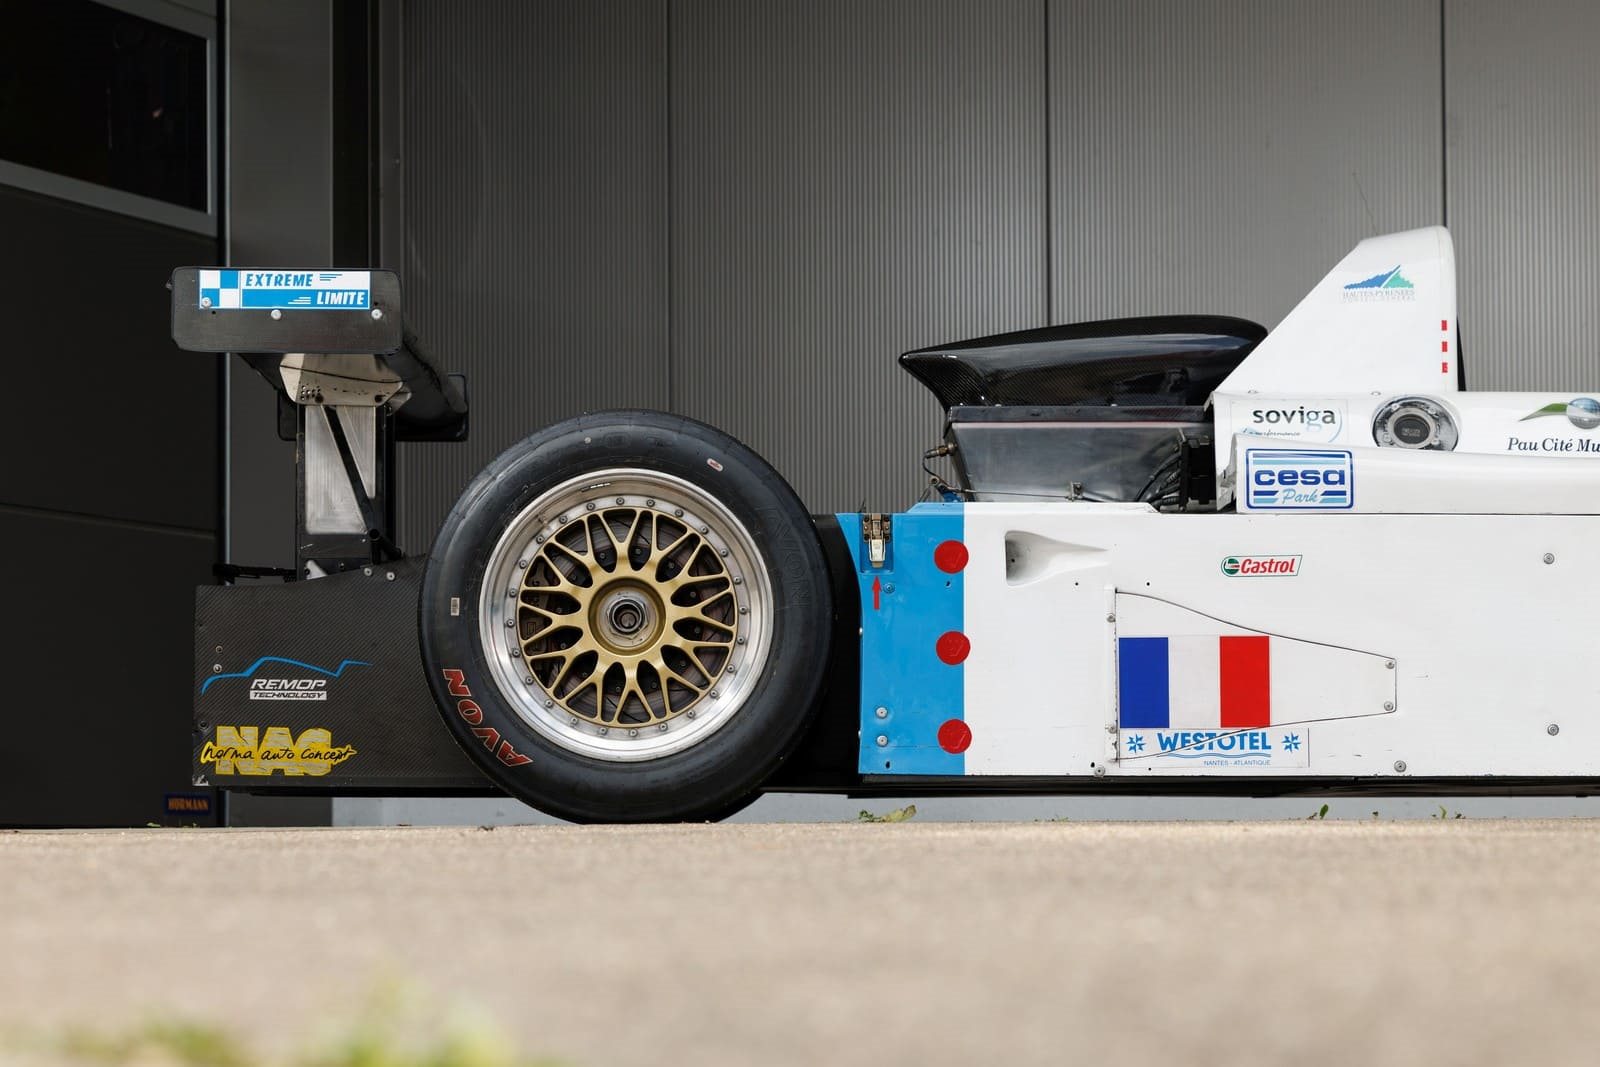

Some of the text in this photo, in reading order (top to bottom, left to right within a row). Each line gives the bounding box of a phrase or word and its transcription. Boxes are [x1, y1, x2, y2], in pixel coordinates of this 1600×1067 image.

[245, 273, 314, 287] EXTREME
[316, 291, 366, 306] LIMITE
[1252, 406, 1336, 432] soviga
[1507, 437, 1539, 452] Pau
[1541, 437, 1573, 452] Cité
[1254, 469, 1346, 486] cesa
[1280, 488, 1319, 504] Park
[1240, 558, 1296, 574] Castrol
[250, 679, 327, 690] REMOP
[253, 691, 325, 699] TECHNOLOGY
[442, 668, 534, 768] AVON
[1156, 731, 1272, 751] WESTOTEL
[215, 726, 332, 776] NAC
[261, 747, 295, 761] auto
[1233, 759, 1271, 767] ATLANTIQUE
